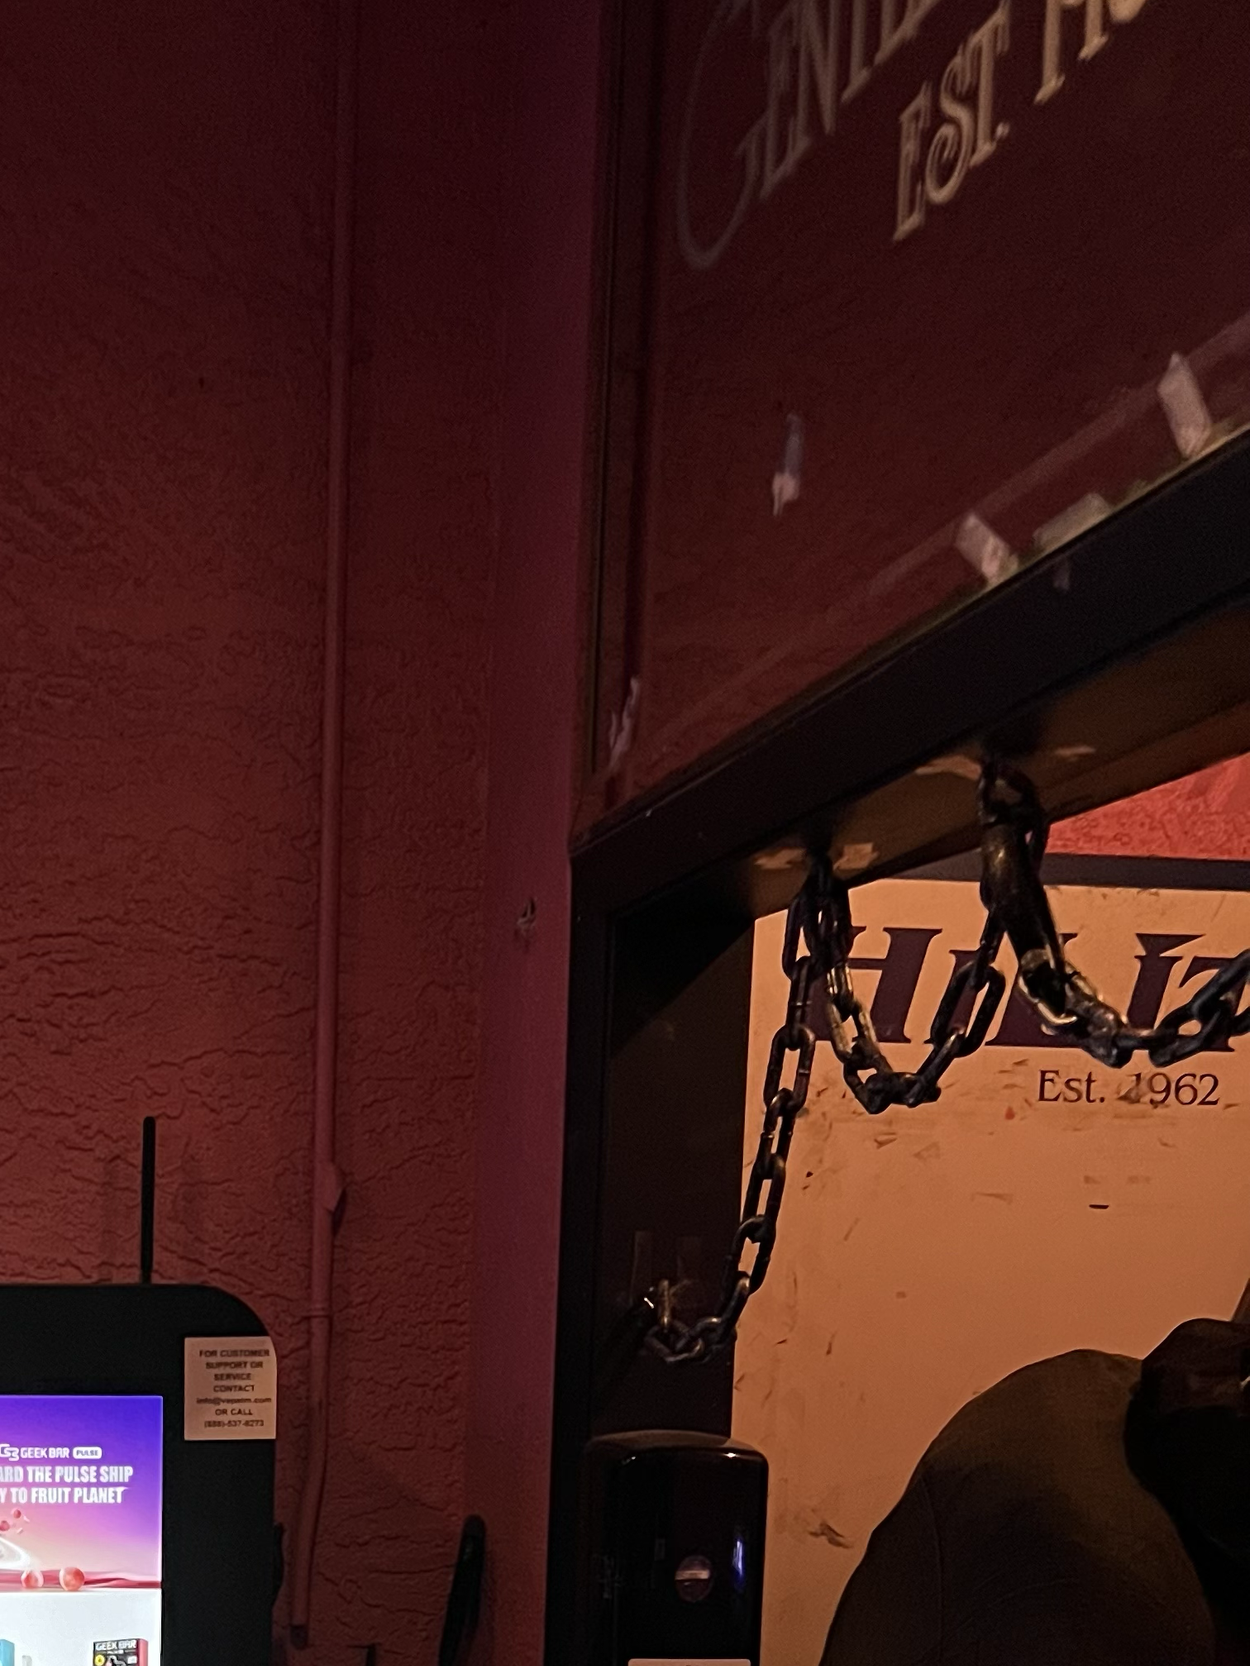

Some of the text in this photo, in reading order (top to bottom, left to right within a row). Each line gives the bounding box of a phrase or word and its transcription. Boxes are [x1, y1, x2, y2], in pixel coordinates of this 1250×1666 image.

[1038, 1069, 1220, 1106] Est. 1962
[199, 1349, 270, 1358] FOR CUSTOMER
[206, 1361, 264, 1369] SUPPORT OR
[214, 1373, 251, 1381] SERVICE
[213, 1385, 255, 1393] CONTACT
[215, 1408, 253, 1416] OR CALL
[20, 1447, 99, 1459] GEEK BAR PULSE
[26, 1465, 52, 1483] THE
[55, 1465, 97, 1483] PULSE
[99, 1465, 134, 1483] SHIP
[10, 1487, 28, 1504] TO
[31, 1487, 71, 1504] FRUIT
[73, 1487, 126, 1504] PLANET
